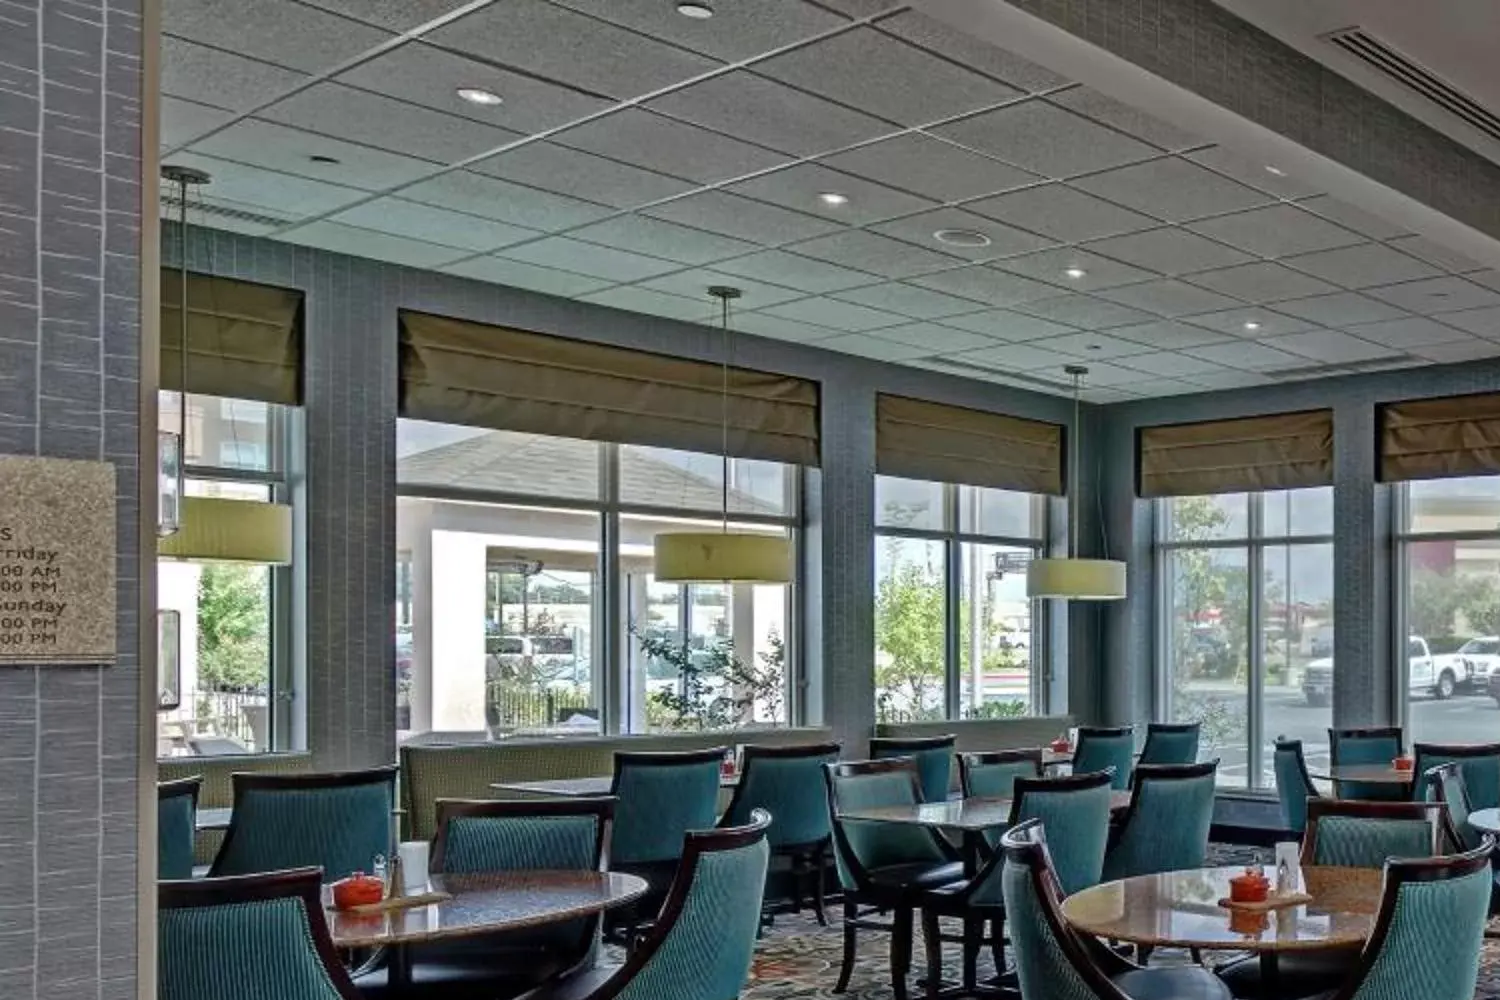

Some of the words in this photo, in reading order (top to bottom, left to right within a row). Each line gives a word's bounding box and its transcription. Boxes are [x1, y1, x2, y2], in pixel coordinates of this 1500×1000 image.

[31, 566, 61, 578] AM
[31, 581, 57, 593] PM
[0, 599, 67, 616] unday
[31, 617, 58, 629] PM
[31, 633, 57, 645] PM
